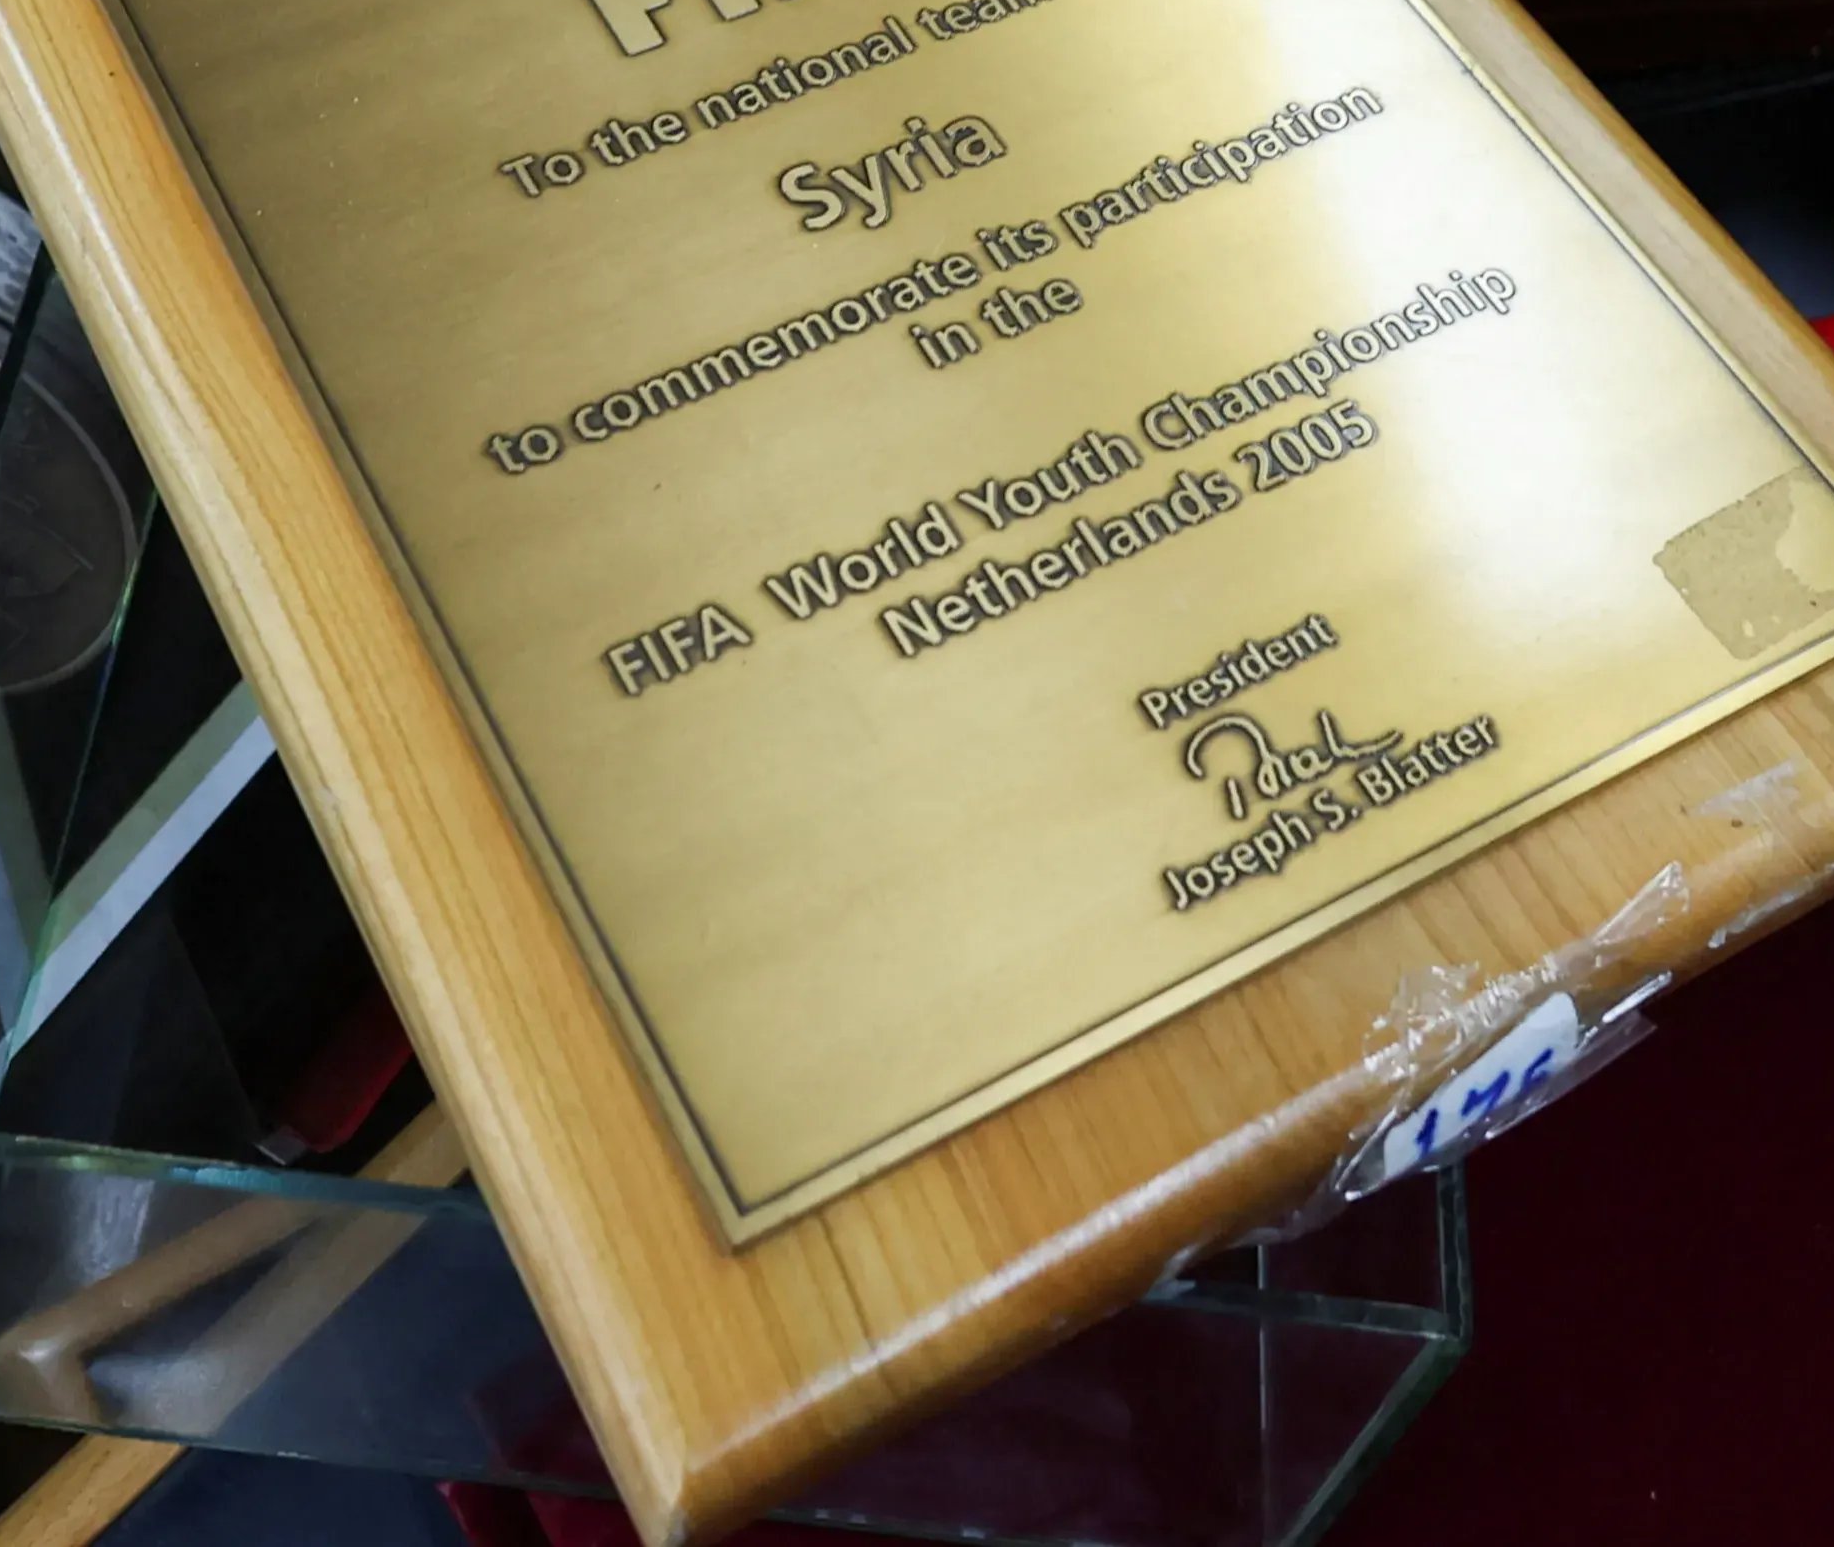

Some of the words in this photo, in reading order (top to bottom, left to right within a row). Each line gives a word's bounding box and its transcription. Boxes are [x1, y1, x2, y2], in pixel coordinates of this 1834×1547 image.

[498, 152, 585, 199] To
[592, 110, 689, 167] the
[697, 16, 917, 130] national
[778, 114, 1009, 231] Syria
[487, 424, 563, 475] to
[570, 251, 982, 443] commemorate
[975, 218, 1059, 272] its
[1059, 84, 1383, 249] participation
[909, 319, 981, 370] in
[981, 276, 1084, 338] the
[605, 602, 755, 697] FIFA
[763, 501, 964, 622] World
[956, 430, 1146, 532] Youth
[1139, 265, 1518, 453] Championship
[879, 466, 1242, 658] Netherlands
[1233, 397, 1378, 495] 2005
[1138, 613, 1341, 729] President
[1161, 811, 1315, 912] Joseph
[1309, 785, 1362, 832] S.
[1354, 712, 1500, 807] Blatter
